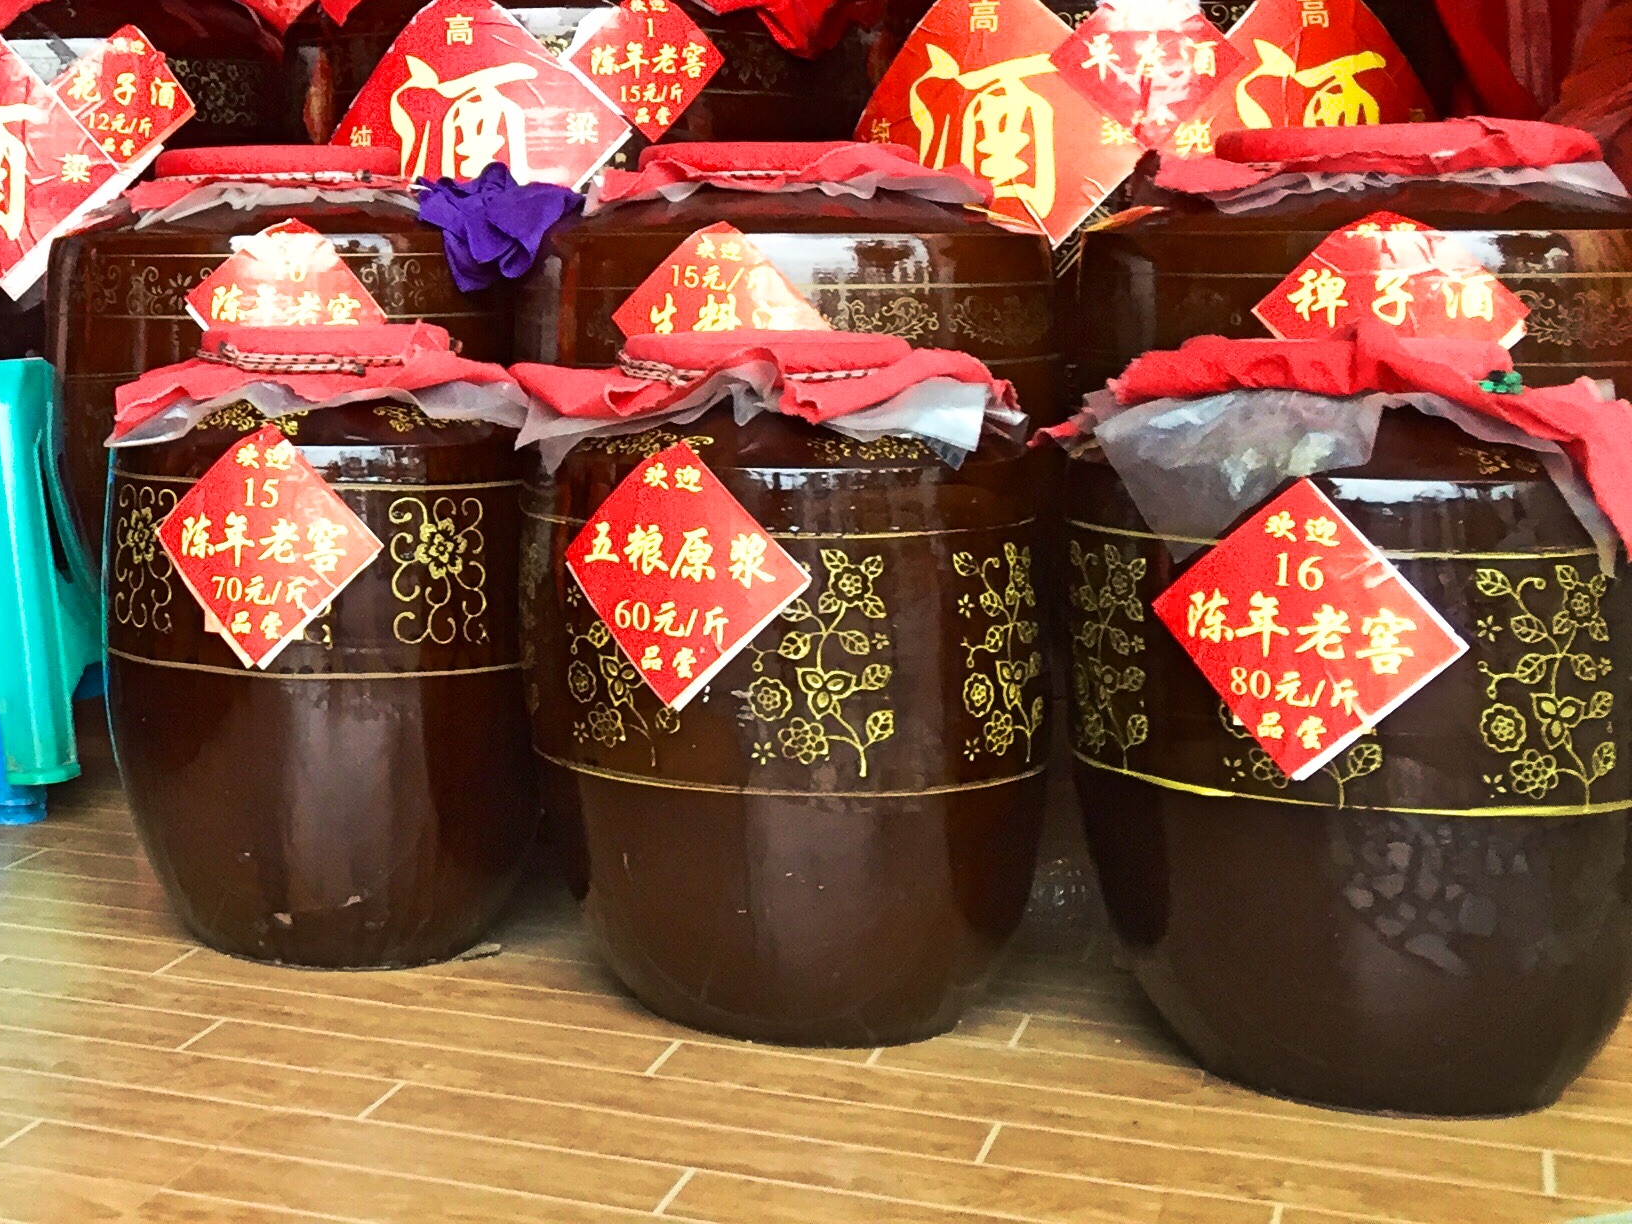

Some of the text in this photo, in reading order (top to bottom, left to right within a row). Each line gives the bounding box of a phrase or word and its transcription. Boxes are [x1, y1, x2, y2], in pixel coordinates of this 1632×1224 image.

[445, 14, 474, 46] 高
[968, 0, 1000, 33] 高
[590, 42, 707, 78] 陈年老窖
[619, 84, 684, 104] 15元/斤
[88, 111, 152, 138] 12元/斤
[390, 55, 538, 186] 酒
[909, 43, 1059, 222] 酒
[1174, 118, 1214, 158] 纯
[695, 235, 743, 261] 欢迎
[235, 443, 292, 471] 欢迎
[243, 478, 279, 508] 15
[643, 465, 702, 492] 欢迎
[181, 512, 348, 574] 陈年老窖
[1265, 511, 1341, 547] 欢迎
[583, 521, 777, 587] 五粮原浆
[1274, 552, 1325, 591] 16
[211, 576, 305, 611] 70元/斤
[230, 611, 280, 641] 品尝
[613, 599, 730, 644] 60元/斤
[1187, 588, 1418, 675] 陈年老窖
[641, 647, 694, 679] 品尝
[1230, 666, 1359, 716] 80元/斤
[1256, 711, 1328, 750] 品尝
